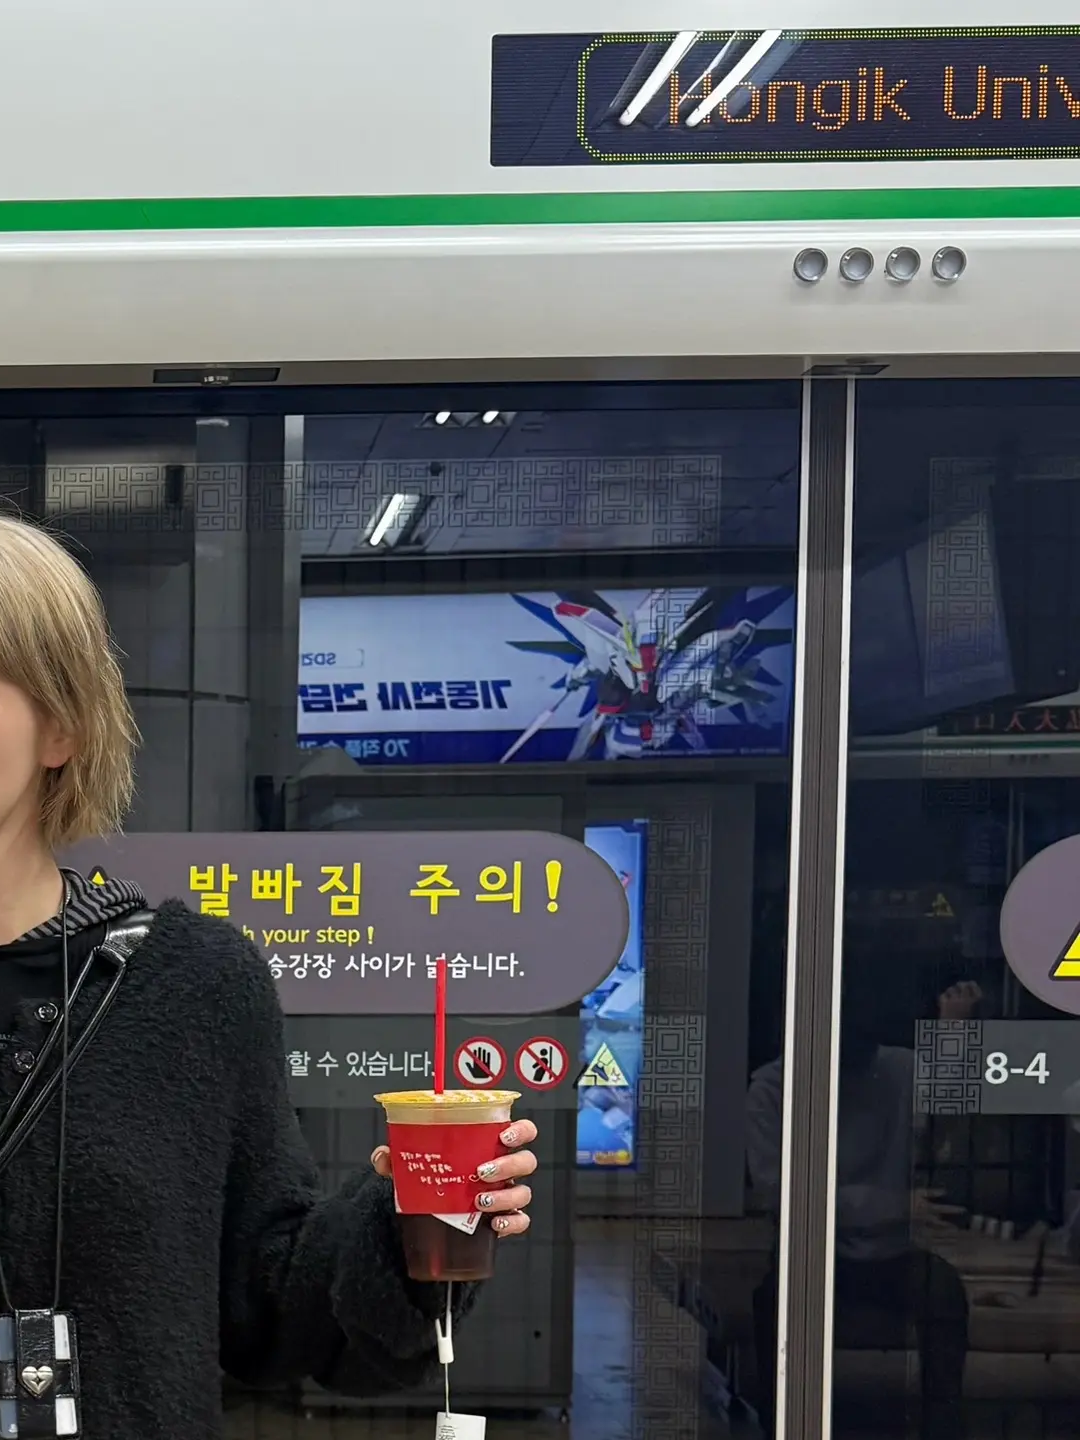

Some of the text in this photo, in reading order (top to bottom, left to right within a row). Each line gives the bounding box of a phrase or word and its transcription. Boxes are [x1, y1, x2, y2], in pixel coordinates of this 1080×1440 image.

[670, 67, 910, 130] Hongik
[262, 929, 309, 946] your
[268, 953, 336, 979] 승강장
[344, 952, 416, 978] 사이가
[316, 1050, 339, 1077] 수
[346, 1050, 436, 1077] 있습니다.
[984, 1052, 1050, 1084] 8-4
